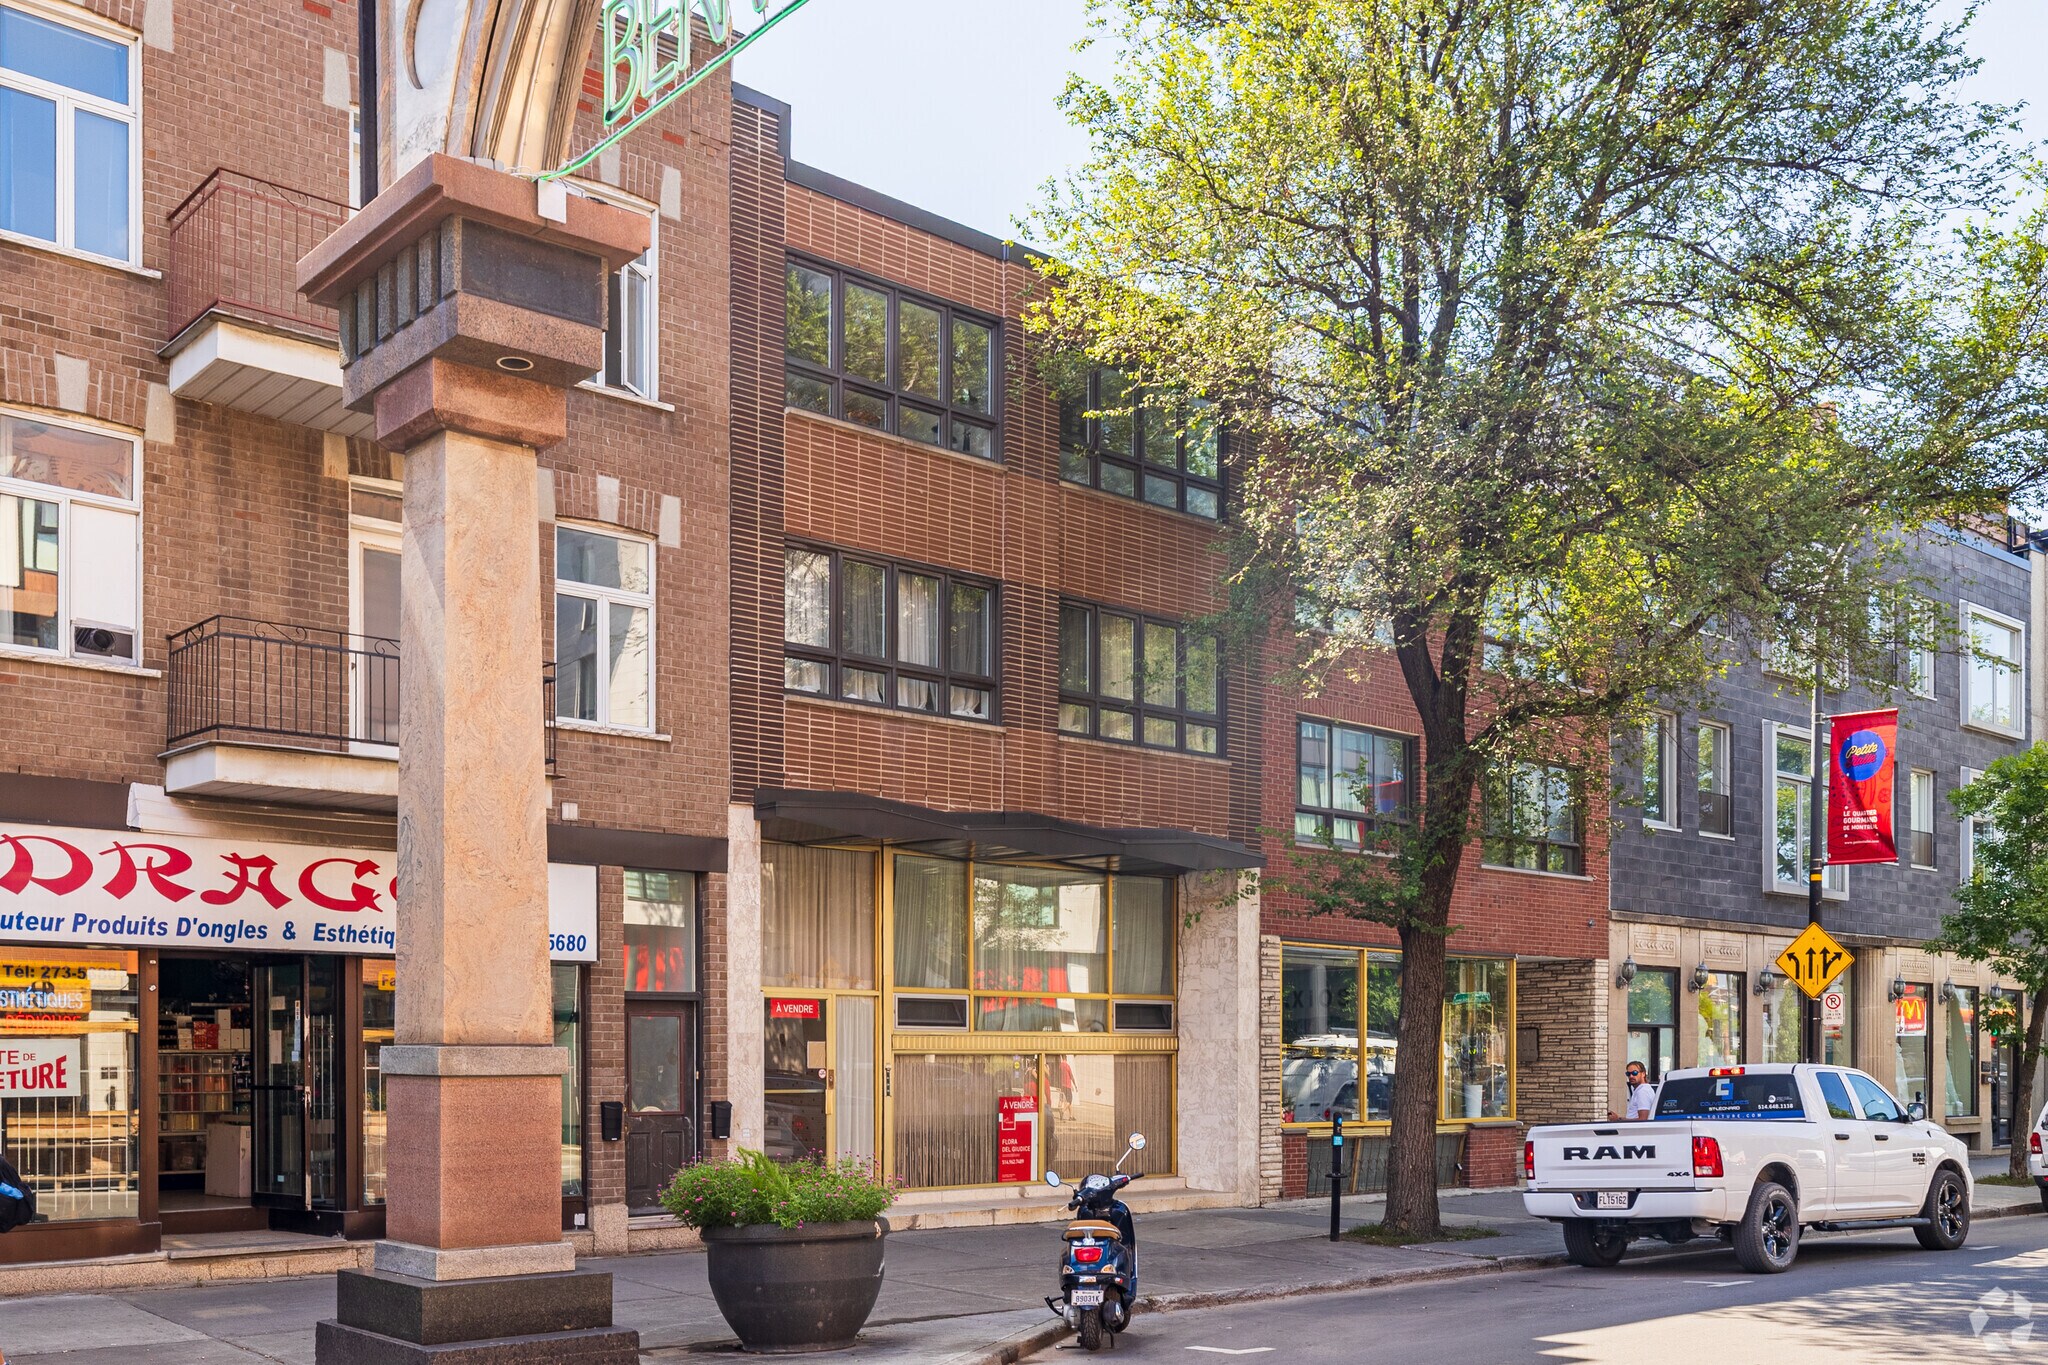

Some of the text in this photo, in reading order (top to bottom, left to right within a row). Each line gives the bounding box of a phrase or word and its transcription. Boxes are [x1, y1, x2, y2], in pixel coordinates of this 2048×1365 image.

[604, 0, 768, 126] BEN
[1846, 742, 1878, 758] Petite
[1843, 816, 1878, 824] GOURMAND
[0, 834, 397, 912] DRAG
[72, 913, 168, 937] Produits
[176, 917, 268, 944] D'ongles
[282, 921, 296, 940] &
[313, 922, 396, 949] Esthétiq
[2, 965, 35, 978] Tél:
[775, 1001, 814, 1014] À VENDRE
[22, 1052, 37, 1061] DE
[1003, 1099, 1034, 1110] À VENDRE
[1563, 1145, 1656, 1161] RAM
